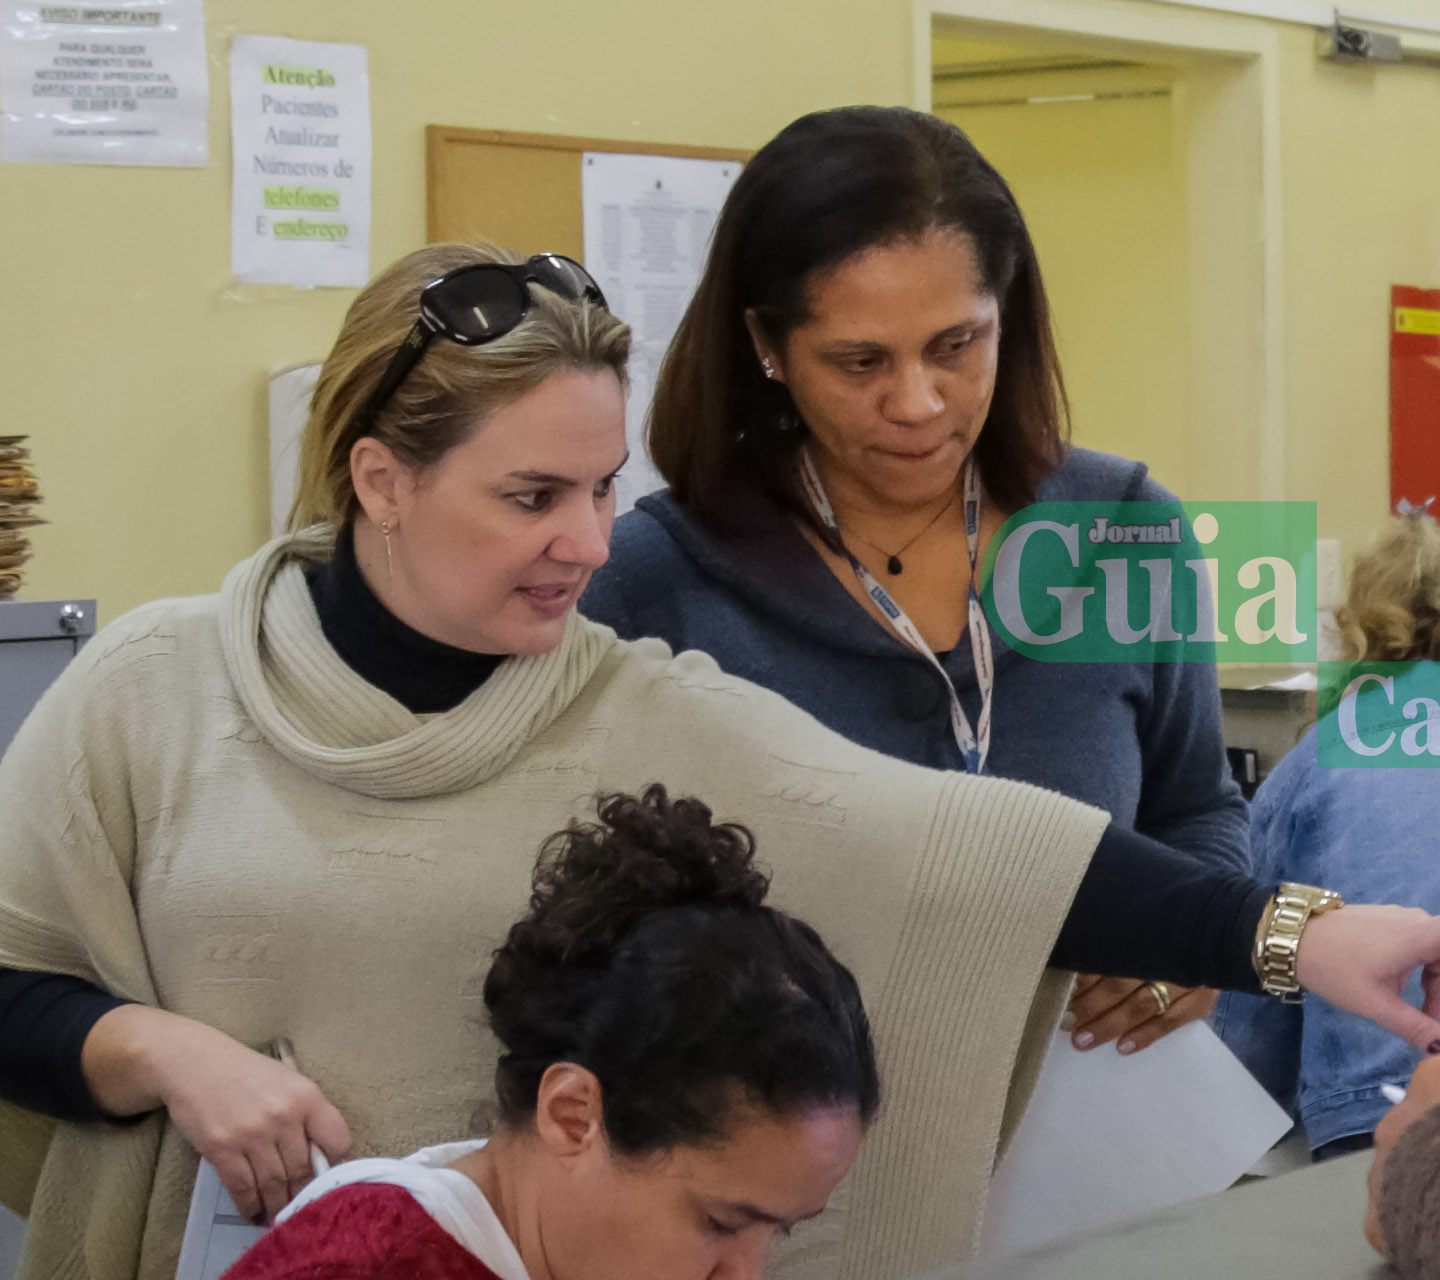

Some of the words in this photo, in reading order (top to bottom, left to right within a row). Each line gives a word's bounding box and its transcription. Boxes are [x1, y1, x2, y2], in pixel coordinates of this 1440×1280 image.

[262, 65, 336, 89] Atenção
[261, 93, 339, 118] Pacientes
[264, 126, 340, 148] Atualizar
[333, 158, 354, 178] de
[264, 186, 340, 209] telefones
[255, 215, 267, 237] E
[273, 218, 349, 242] endereço
